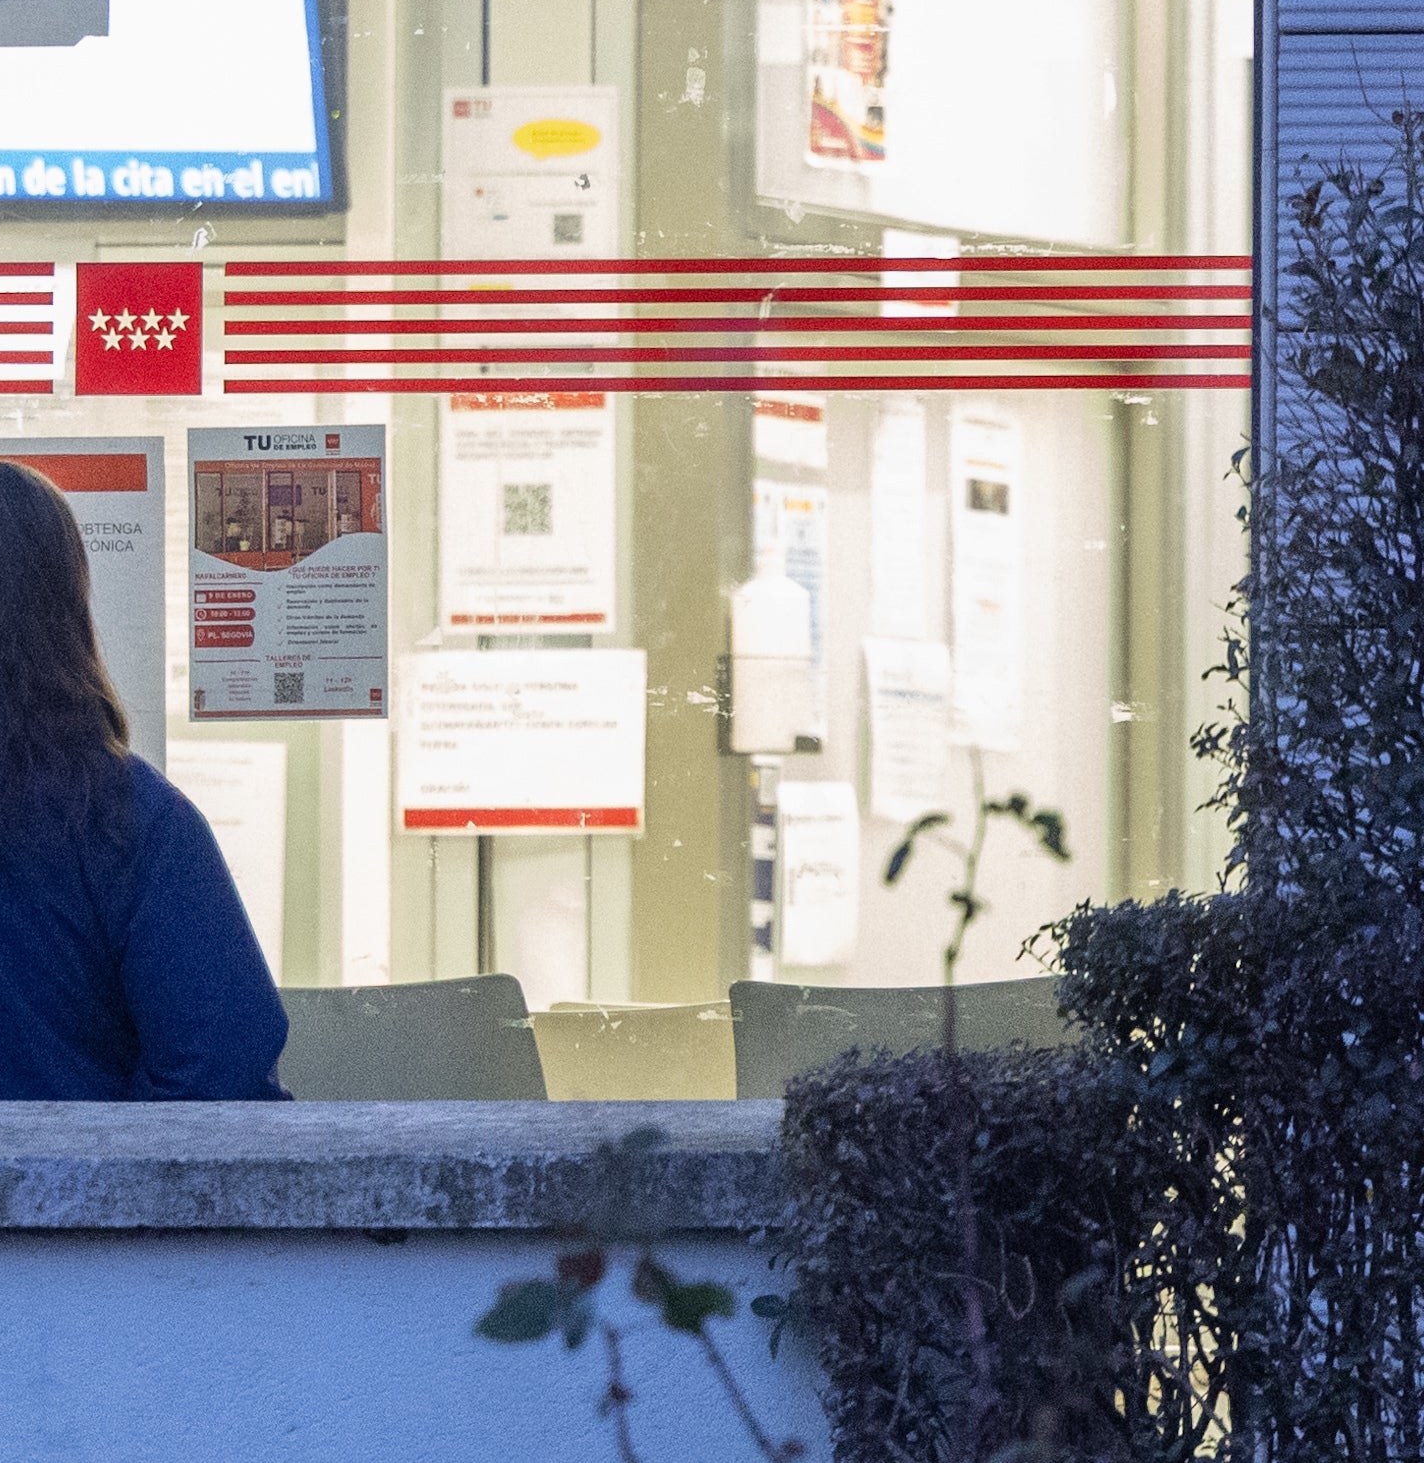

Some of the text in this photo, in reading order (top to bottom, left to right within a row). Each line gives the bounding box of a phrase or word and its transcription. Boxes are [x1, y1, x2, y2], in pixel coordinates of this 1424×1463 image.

[22, 157, 67, 197] de
[71, 157, 105, 197] la
[111, 158, 174, 198] cita
[180, 164, 224, 198] en
[232, 159, 263, 198] el
[244, 434, 316, 451] TU OFICINA
